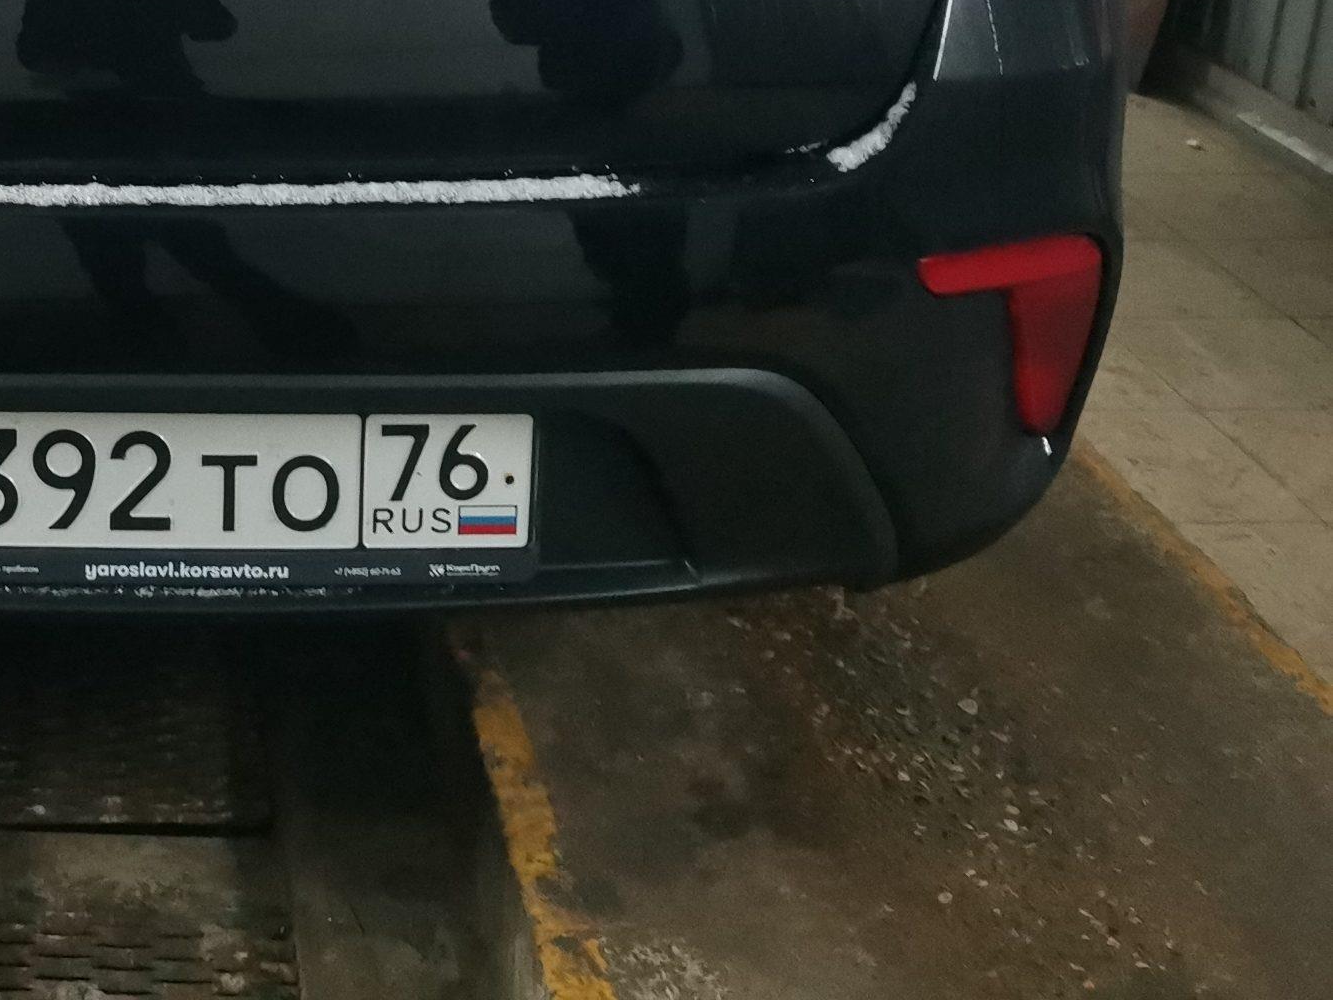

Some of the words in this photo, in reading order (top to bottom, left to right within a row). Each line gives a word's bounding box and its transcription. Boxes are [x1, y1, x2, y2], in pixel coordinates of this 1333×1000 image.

[380, 423, 489, 502] 76
[372, 507, 452, 534] RUS
[84, 561, 289, 581] yaroslavl.korsavto.ru
